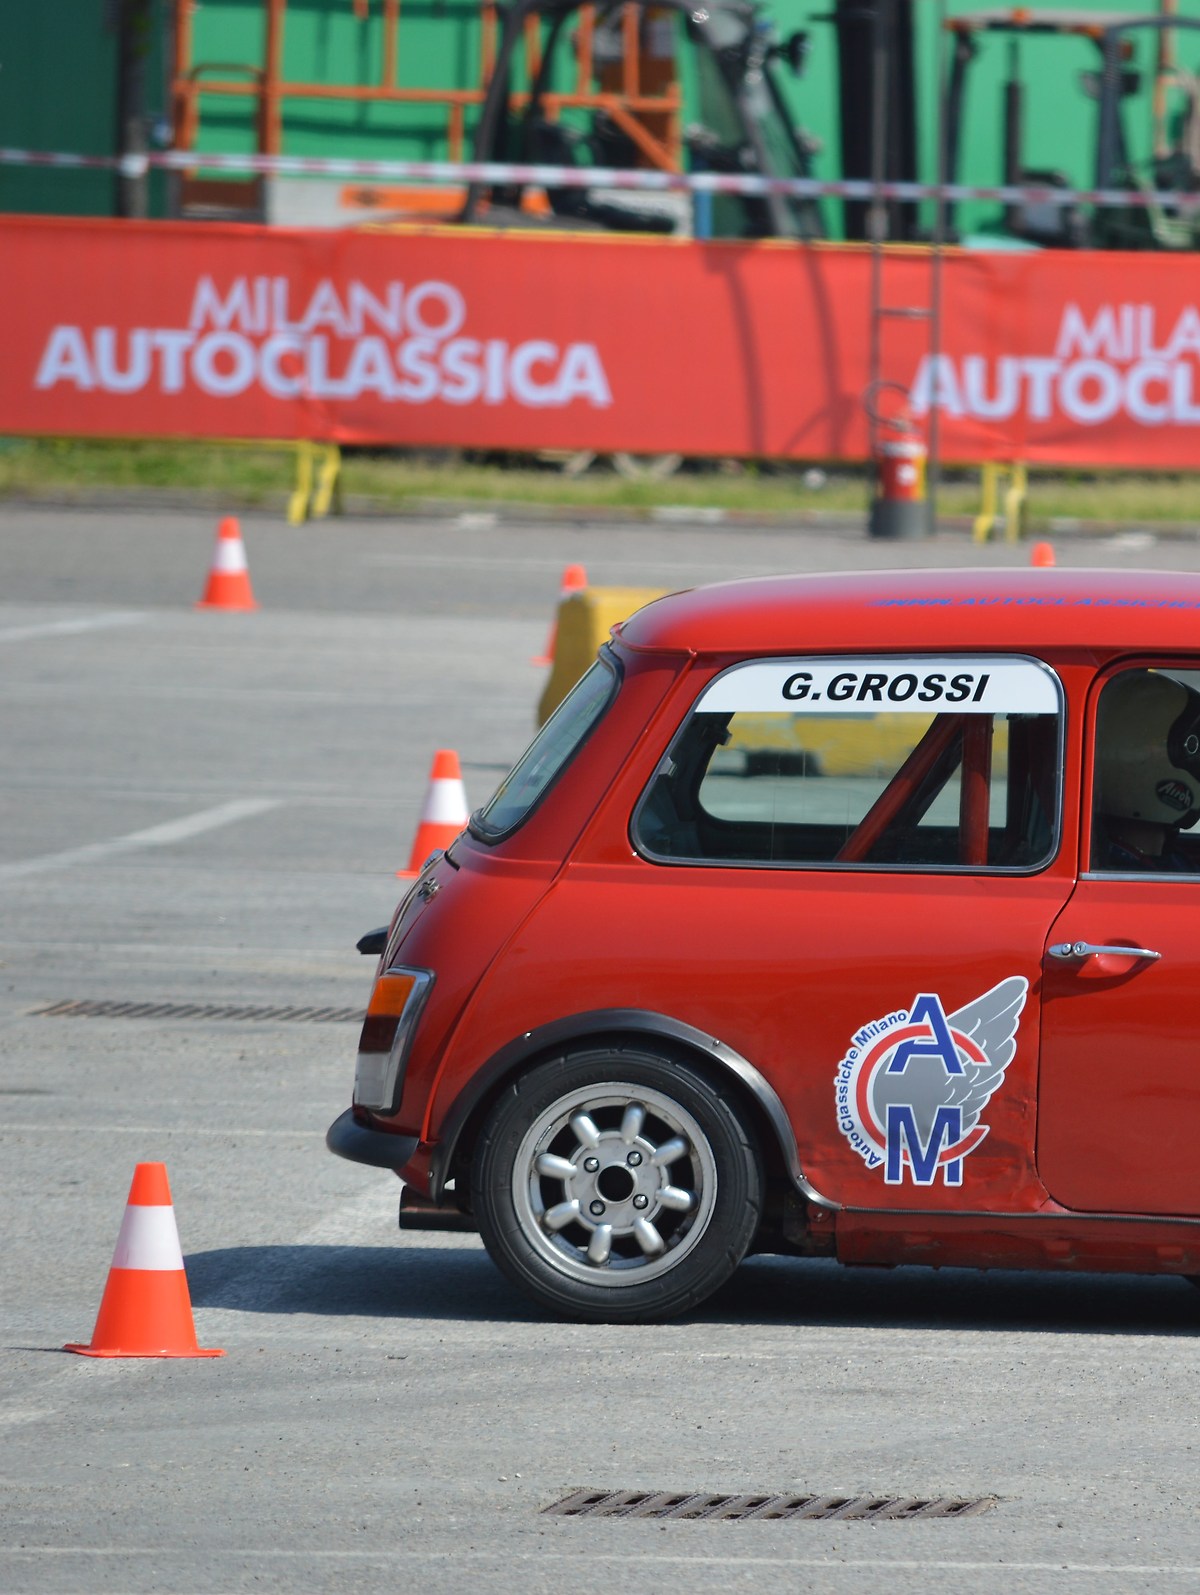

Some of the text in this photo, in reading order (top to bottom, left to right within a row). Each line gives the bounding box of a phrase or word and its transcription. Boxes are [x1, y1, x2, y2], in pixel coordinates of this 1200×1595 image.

[189, 276, 467, 341] MILANO
[34, 325, 613, 408] AUTOCLASSICA
[781, 672, 991, 703] G.GROSSI
[854, 1011, 907, 1047] Milano
[837, 1049, 882, 1167] AutoClassiche
